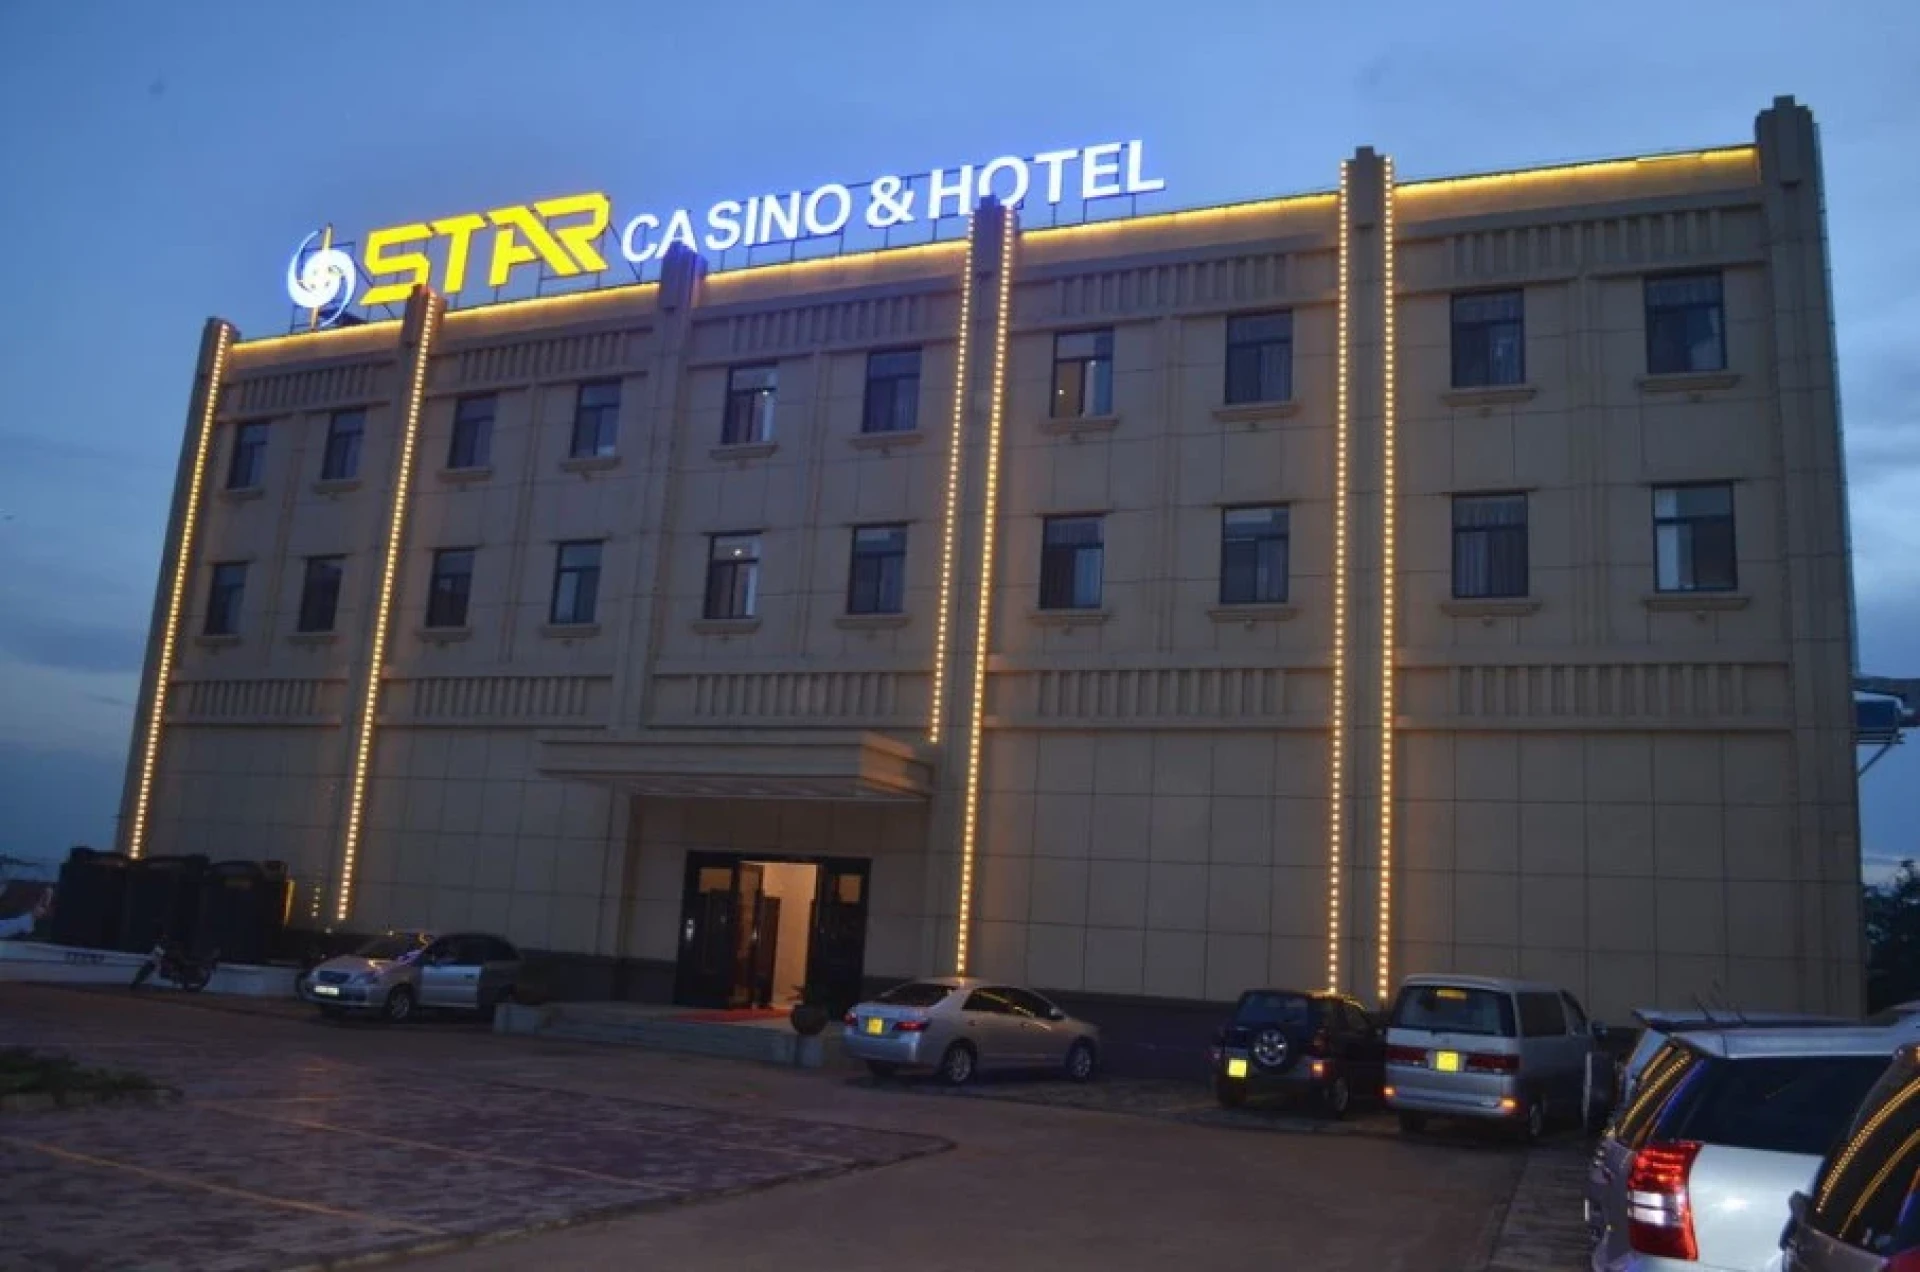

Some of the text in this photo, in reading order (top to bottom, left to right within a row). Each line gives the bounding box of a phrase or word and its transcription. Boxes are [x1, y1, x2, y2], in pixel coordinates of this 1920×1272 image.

[360, 139, 1166, 305] STAR CASINO & HOTEL
